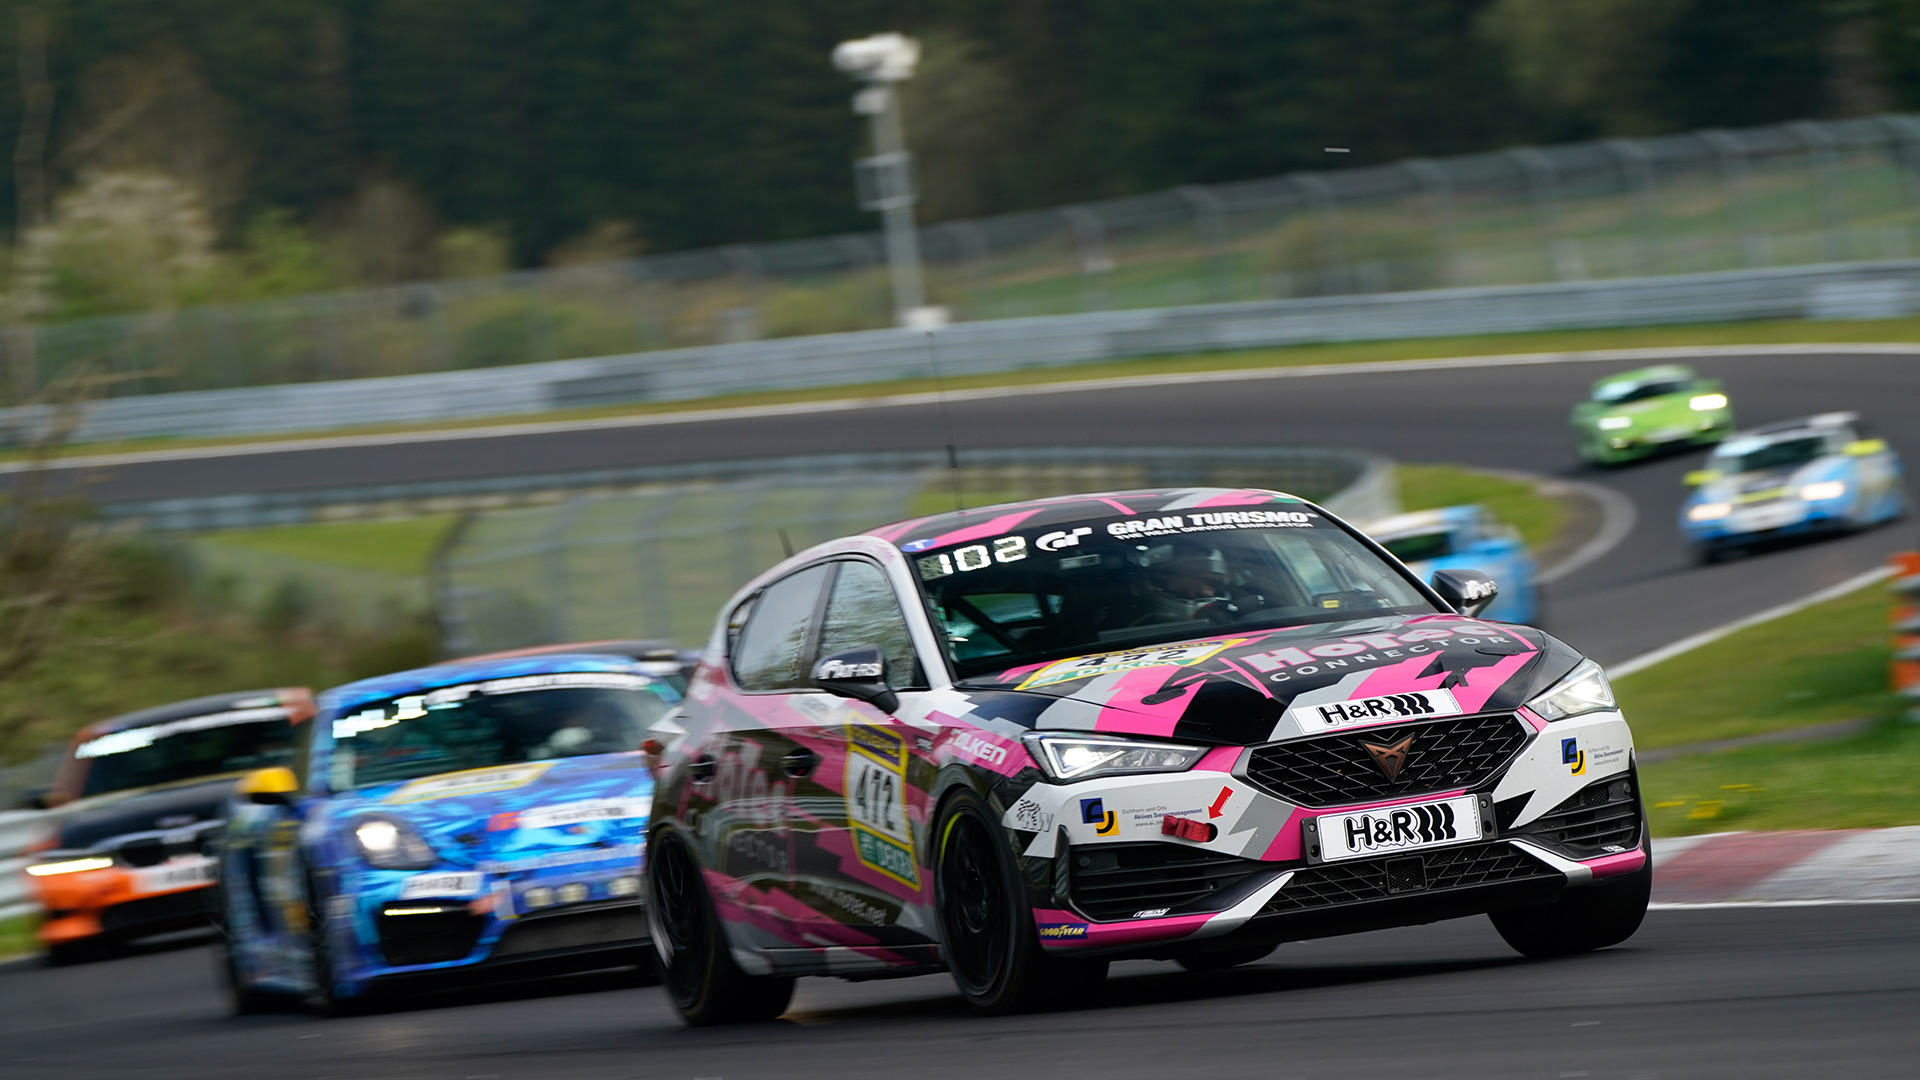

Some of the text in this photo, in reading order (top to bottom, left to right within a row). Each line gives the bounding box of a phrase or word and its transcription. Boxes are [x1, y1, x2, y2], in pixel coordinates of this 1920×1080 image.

[1106, 516, 1184, 535] GRAN
[1113, 533, 1143, 541] THE
[1143, 529, 1181, 537] REAL
[1181, 524, 1237, 532] DRIVING
[939, 535, 1028, 574] 102
[1270, 635, 1511, 683] CONNECTOR
[1318, 699, 1392, 724] H&R
[855, 764, 895, 831] 472
[1345, 811, 1415, 849] H&R
[1040, 924, 1085, 938] GOODYEAR
